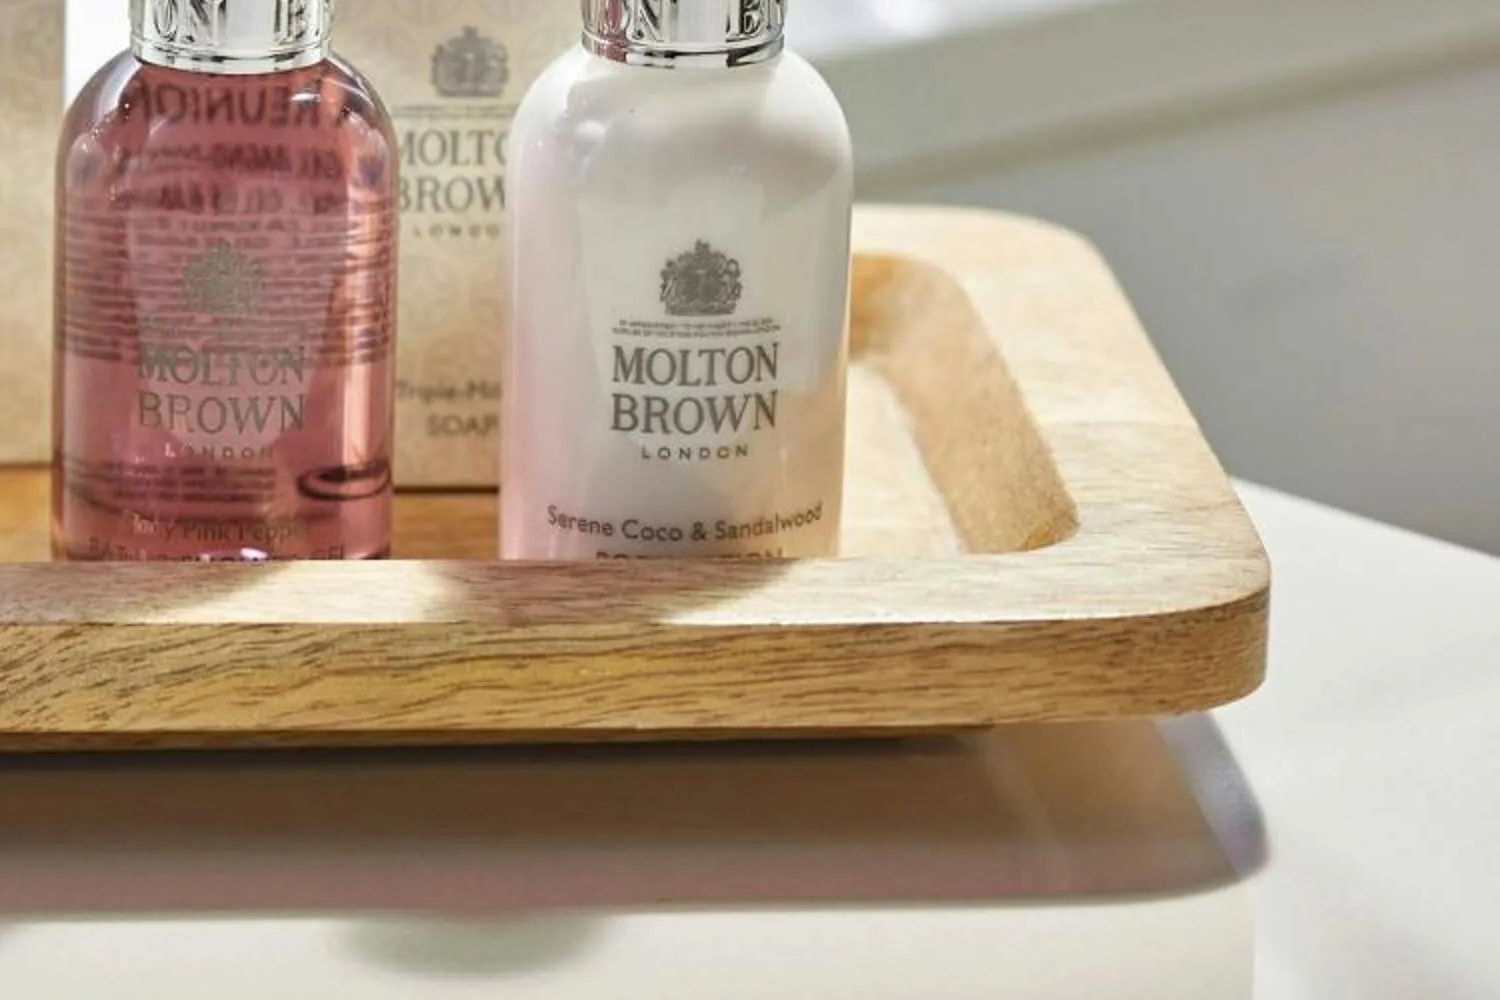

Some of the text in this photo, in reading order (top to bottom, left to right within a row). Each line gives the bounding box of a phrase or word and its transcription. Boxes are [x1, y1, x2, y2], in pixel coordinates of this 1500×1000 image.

[397, 174, 506, 214] BROW
[412, 222, 500, 239] LONDO
[137, 345, 305, 387] MOLTON
[612, 342, 779, 387] MOLTON
[137, 390, 307, 435] BROWN
[610, 390, 778, 435] BROWN
[164, 442, 274, 460] LONDON
[641, 444, 748, 461] LONDON
[181, 519, 229, 541] Pink
[546, 501, 823, 542] Serene Coco & Sandalwood
